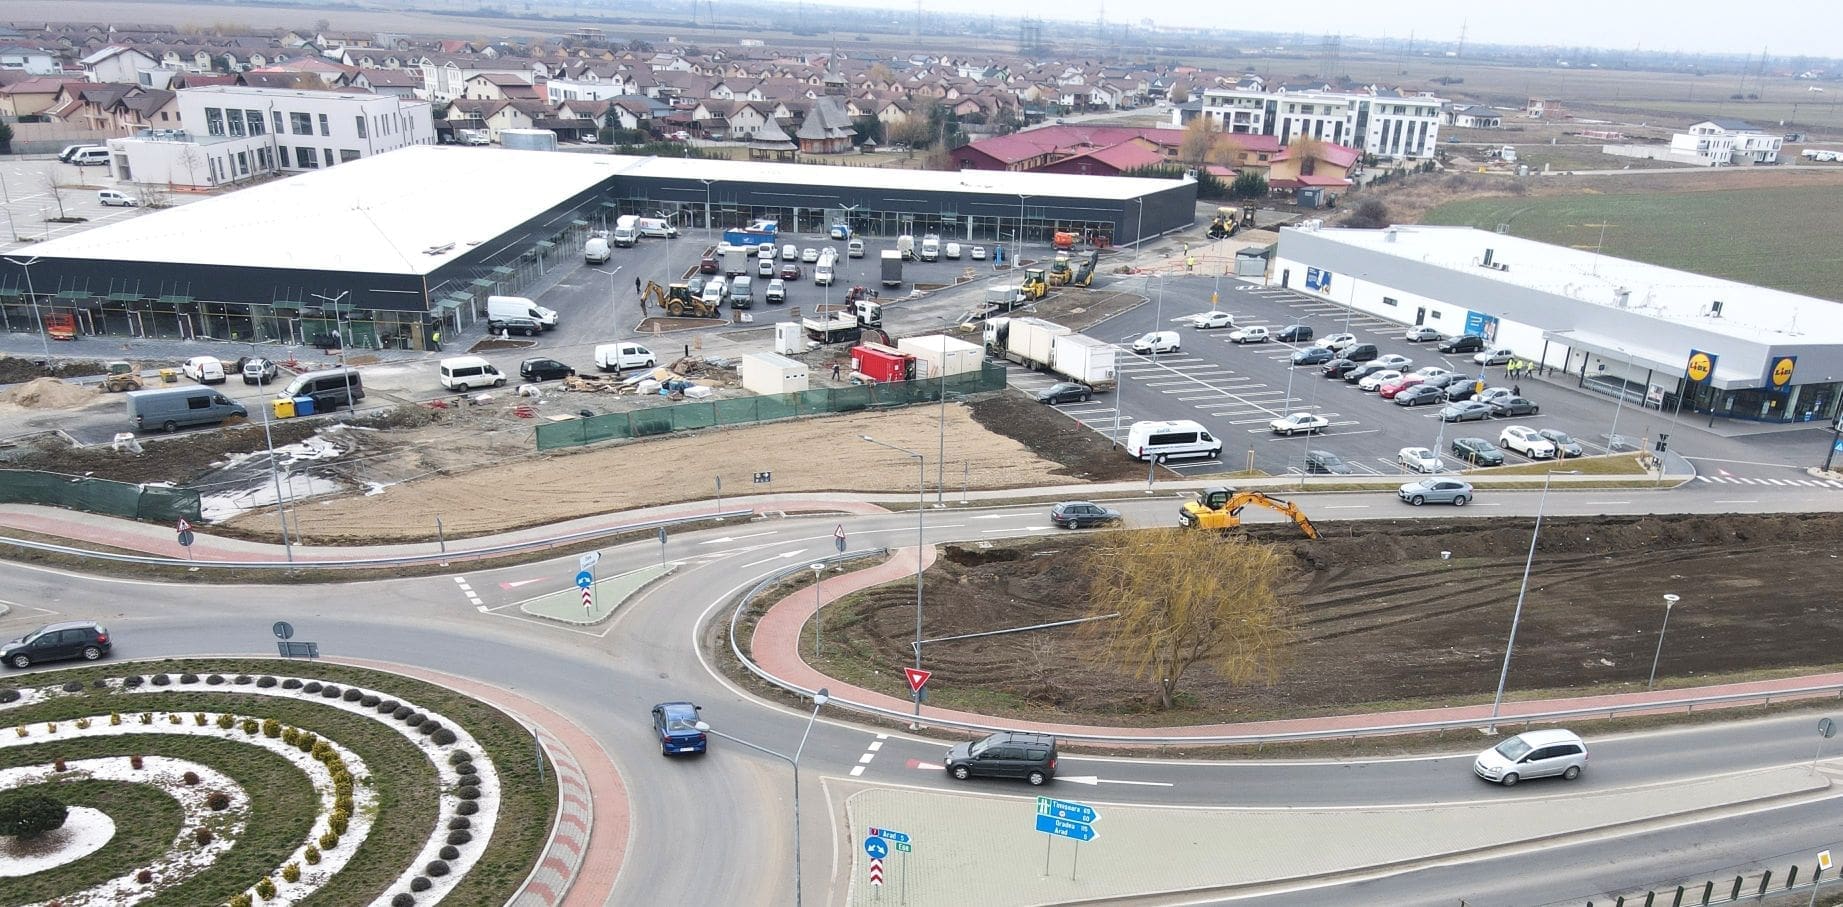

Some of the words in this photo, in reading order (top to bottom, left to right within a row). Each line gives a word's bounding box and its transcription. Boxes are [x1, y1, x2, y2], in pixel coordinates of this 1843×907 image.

[1055, 820, 1076, 830] Oradea
[882, 830, 897, 839] Arad
[1054, 827, 1069, 836] Arad
